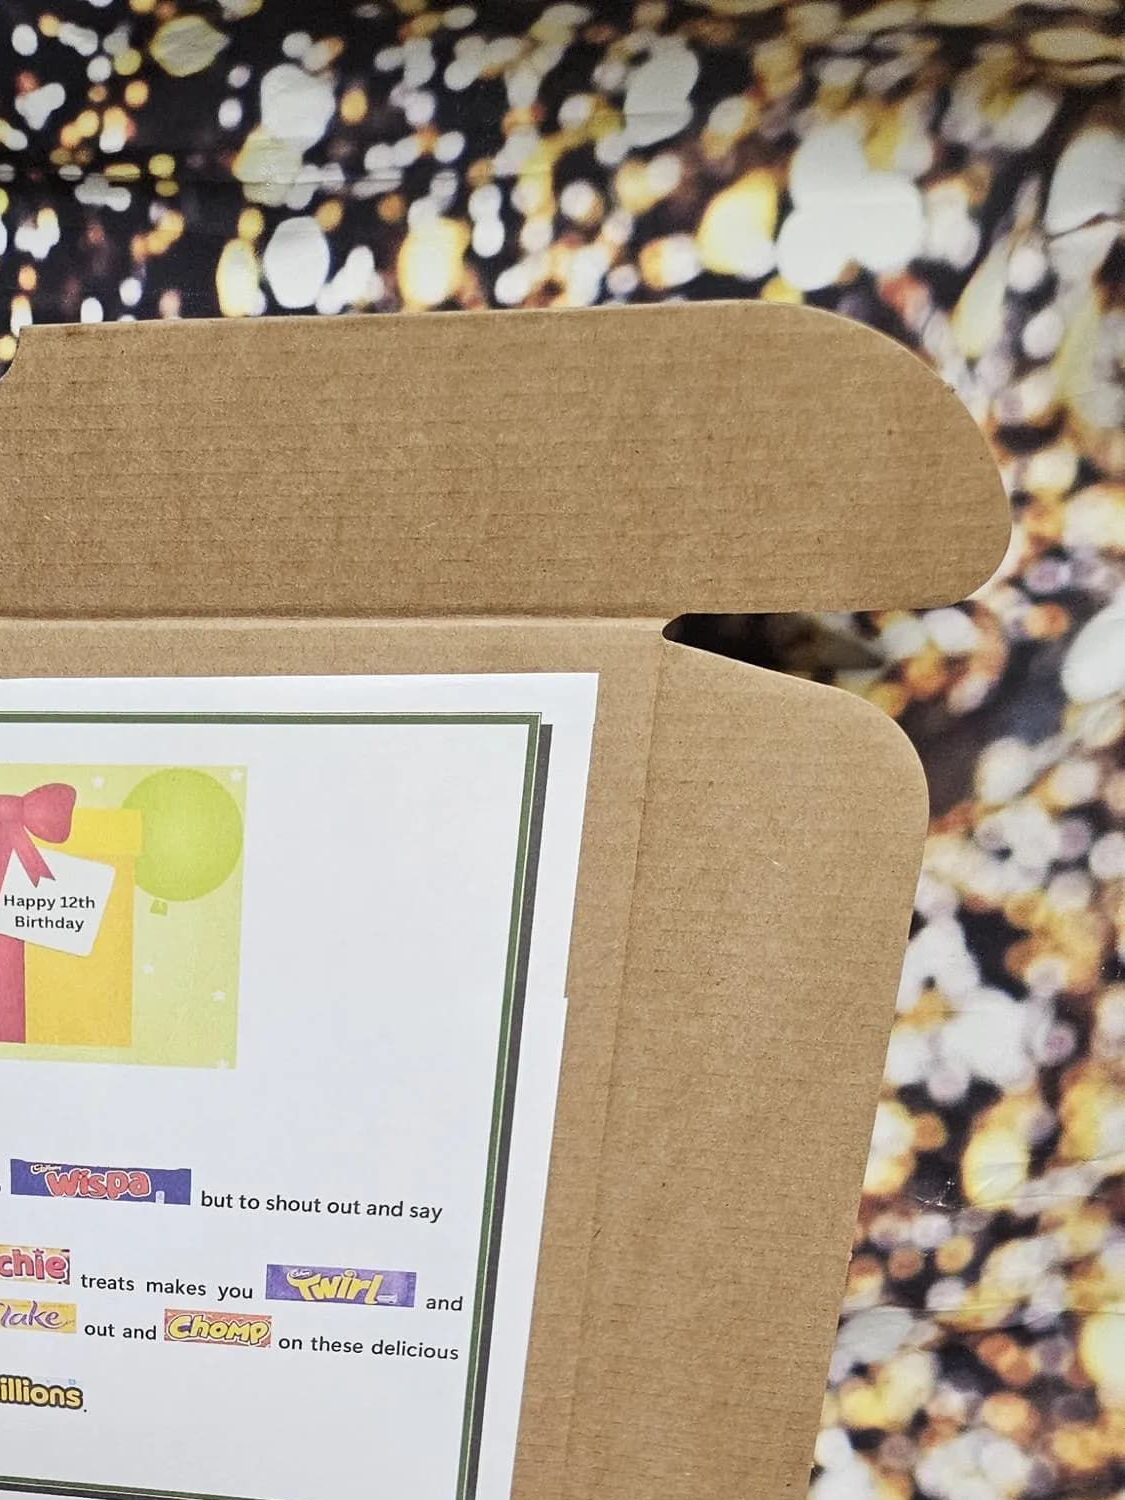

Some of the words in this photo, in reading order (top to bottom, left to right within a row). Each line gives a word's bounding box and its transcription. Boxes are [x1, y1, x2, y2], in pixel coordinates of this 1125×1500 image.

[3, 895, 55, 910] Happy
[60, 896, 95, 909] 12th
[14, 916, 84, 932] Birthday
[201, 1191, 233, 1209] but
[239, 1193, 260, 1210] to
[266, 1195, 321, 1214] shout
[327, 1199, 360, 1215] out
[366, 1200, 403, 1218] and
[409, 1205, 442, 1223] say
[81, 1273, 135, 1293] treats
[146, 1277, 207, 1297] makes
[217, 1284, 253, 1302] you
[287, 1270, 380, 1306] Twirl
[426, 1295, 463, 1311] and
[85, 1322, 115, 1339] out
[122, 1324, 157, 1341] and
[278, 1337, 303, 1352] on
[310, 1335, 364, 1354] these
[371, 1339, 459, 1361] delicious
